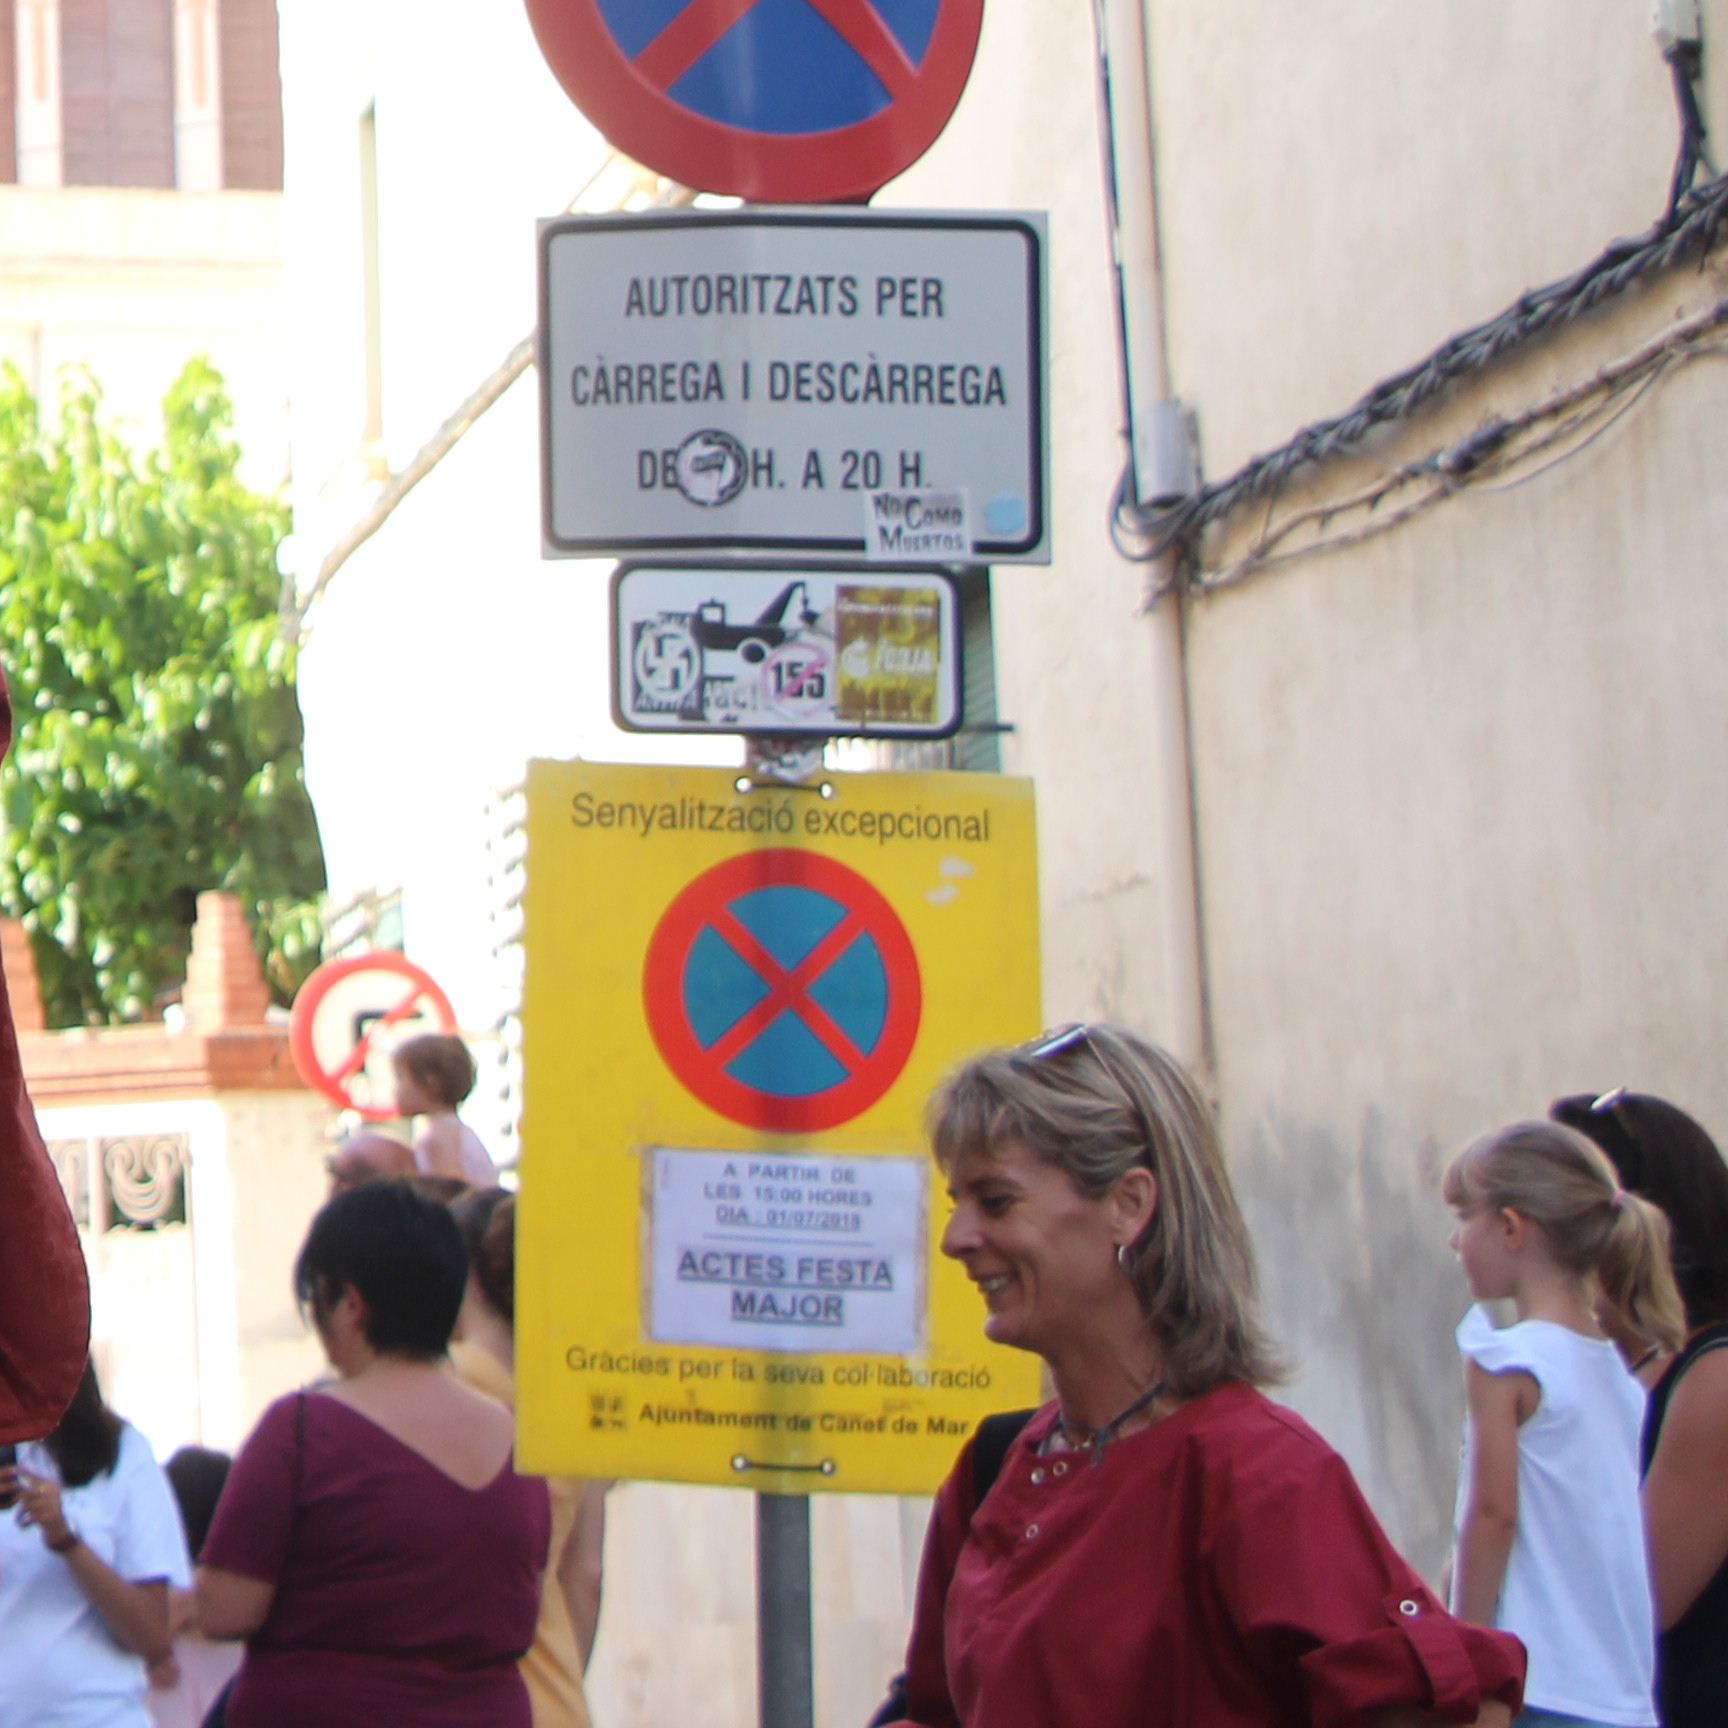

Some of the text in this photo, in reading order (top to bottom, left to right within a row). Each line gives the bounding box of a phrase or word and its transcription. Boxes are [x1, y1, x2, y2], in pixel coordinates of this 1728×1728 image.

[624, 275, 945, 318] AUTORITZATS PER
[570, 352, 1007, 407] CÀRREGA I DESCÀRREGA
[801, 450, 825, 490] A
[840, 449, 882, 490] 20
[772, 661, 826, 699] 155
[571, 792, 991, 846] Senyalització excepcional
[723, 1162, 857, 1184] A PARTIR DE
[704, 1182, 741, 1200] LES
[808, 1188, 873, 1207] HORES
[716, 1204, 749, 1223] DIA
[678, 1250, 894, 1286] ACTES FESTA
[731, 1290, 844, 1321] MAJOR
[565, 1345, 670, 1377] Gràcies
[678, 1356, 722, 1383] per
[731, 1357, 754, 1382] la
[765, 1362, 825, 1386] seva
[638, 1403, 970, 1438] Ajuntament de Canet de Mar
